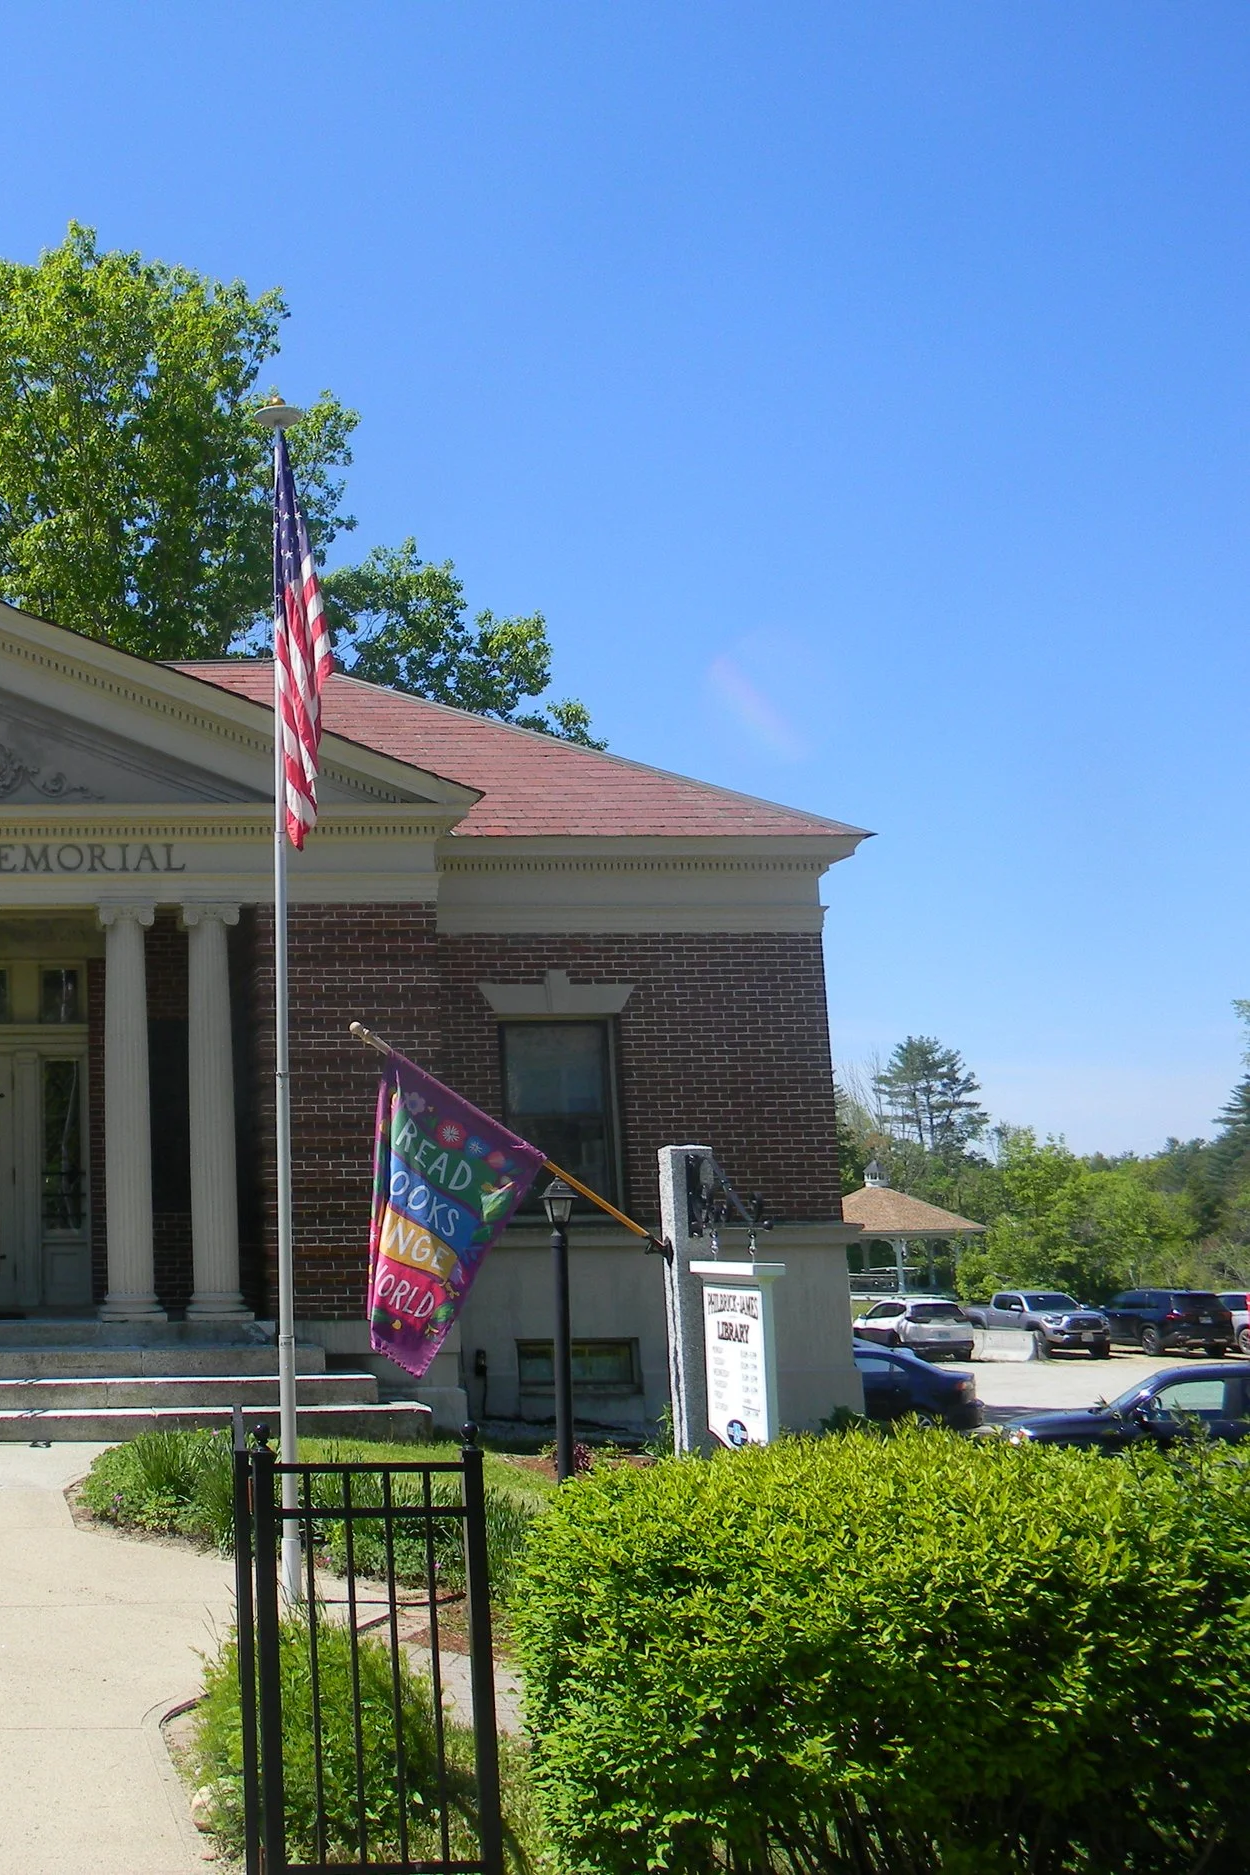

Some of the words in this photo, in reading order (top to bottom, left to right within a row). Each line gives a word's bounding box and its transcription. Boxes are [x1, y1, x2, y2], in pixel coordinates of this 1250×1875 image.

[395, 1117, 473, 1192] READ
[390, 1169, 460, 1238] OOKS
[717, 1321, 750, 1344] LIBRARY
